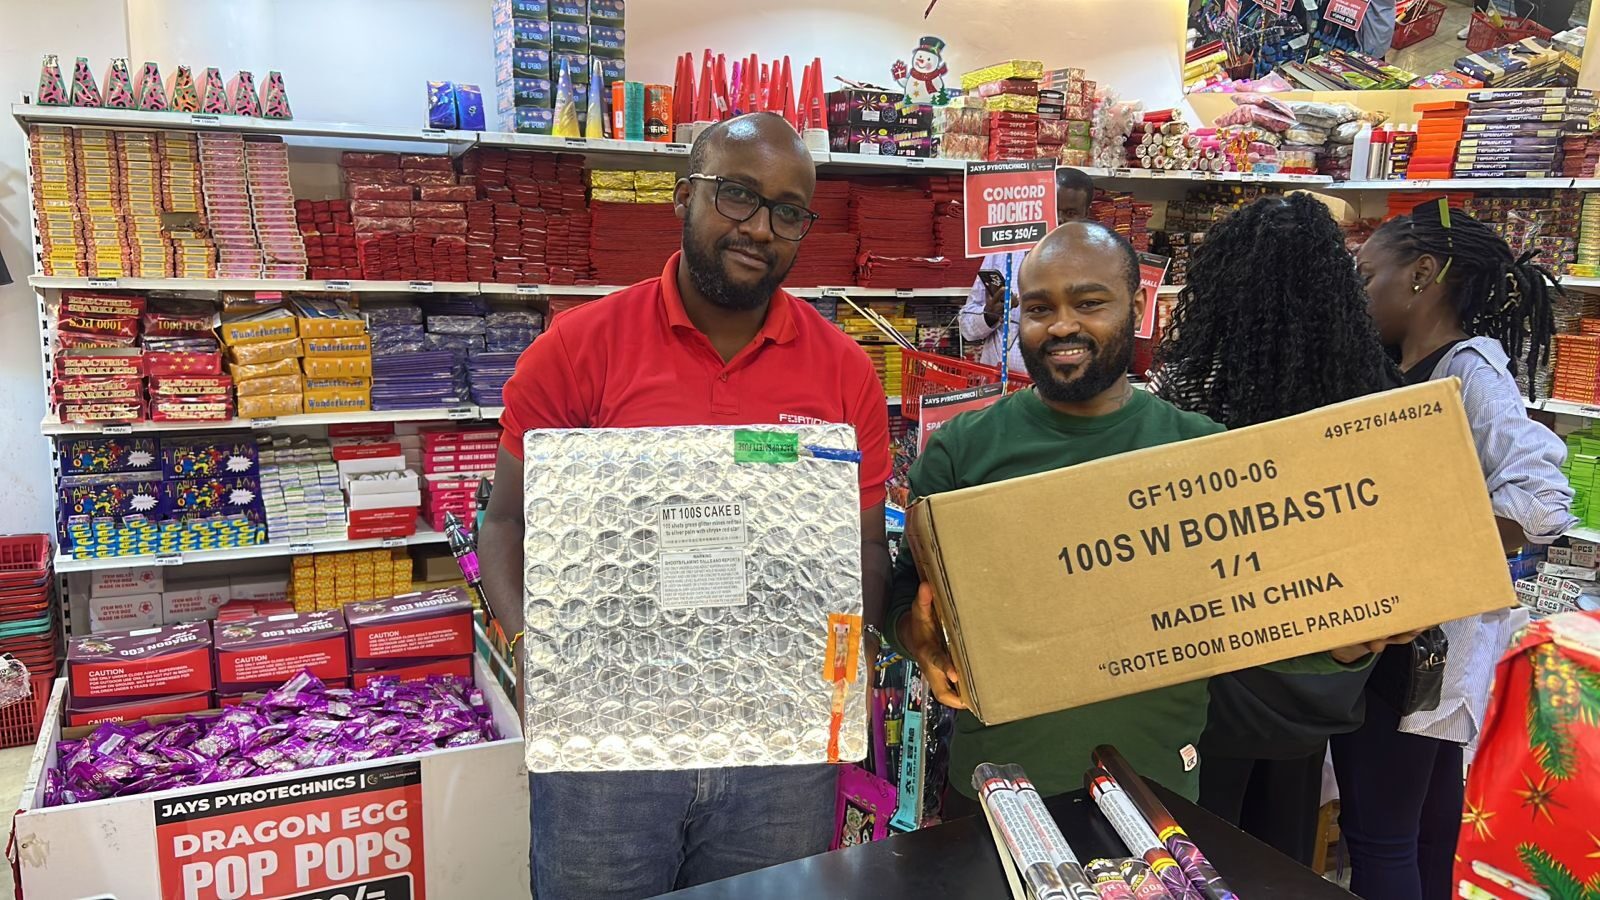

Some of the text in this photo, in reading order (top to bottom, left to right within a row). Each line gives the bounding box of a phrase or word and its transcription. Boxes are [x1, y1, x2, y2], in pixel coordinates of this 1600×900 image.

[983, 185, 1046, 201] CONCORD
[988, 200, 1042, 224] ROCKETS
[992, 226, 1038, 241] KES 250/=
[1140, 279, 1158, 288] MALL
[68, 296, 131, 306] ELECTRIC
[231, 326, 292, 339] Wunderkerzen
[309, 342, 367, 352] Wunderkerzen
[308, 398, 366, 407] Wunderkerzen
[779, 414, 831, 424] FORTIN
[1324, 401, 1444, 440] 49F276/448/24
[1128, 459, 1278, 510] GF19100-06
[663, 505, 740, 520] MT 100S CAKE B
[1057, 478, 1379, 575] 100S W BOMBASTIC
[1210, 551, 1262, 580] 1/1
[1517, 582, 1535, 592] 6PCS
[414, 596, 458, 608] DRAGON
[1151, 572, 1344, 631] MADE IN CHINA
[1562, 594, 1576, 603] 6PC
[287, 623, 333, 635] DRAGON
[368, 631, 399, 640] CAUTION
[1098, 595, 1400, 676] “GROTE BOOM BOMBEL PARADIJS”
[147, 635, 197, 651] DRAGON
[235, 655, 268, 664] CAUTION
[89, 668, 124, 677] CAUTION
[88, 716, 123, 725] CAUTION
[162, 776, 356, 818] JAYS PYROTECHNICS
[173, 800, 408, 858] DRAGON EGG
[182, 827, 412, 900] POP POPS
